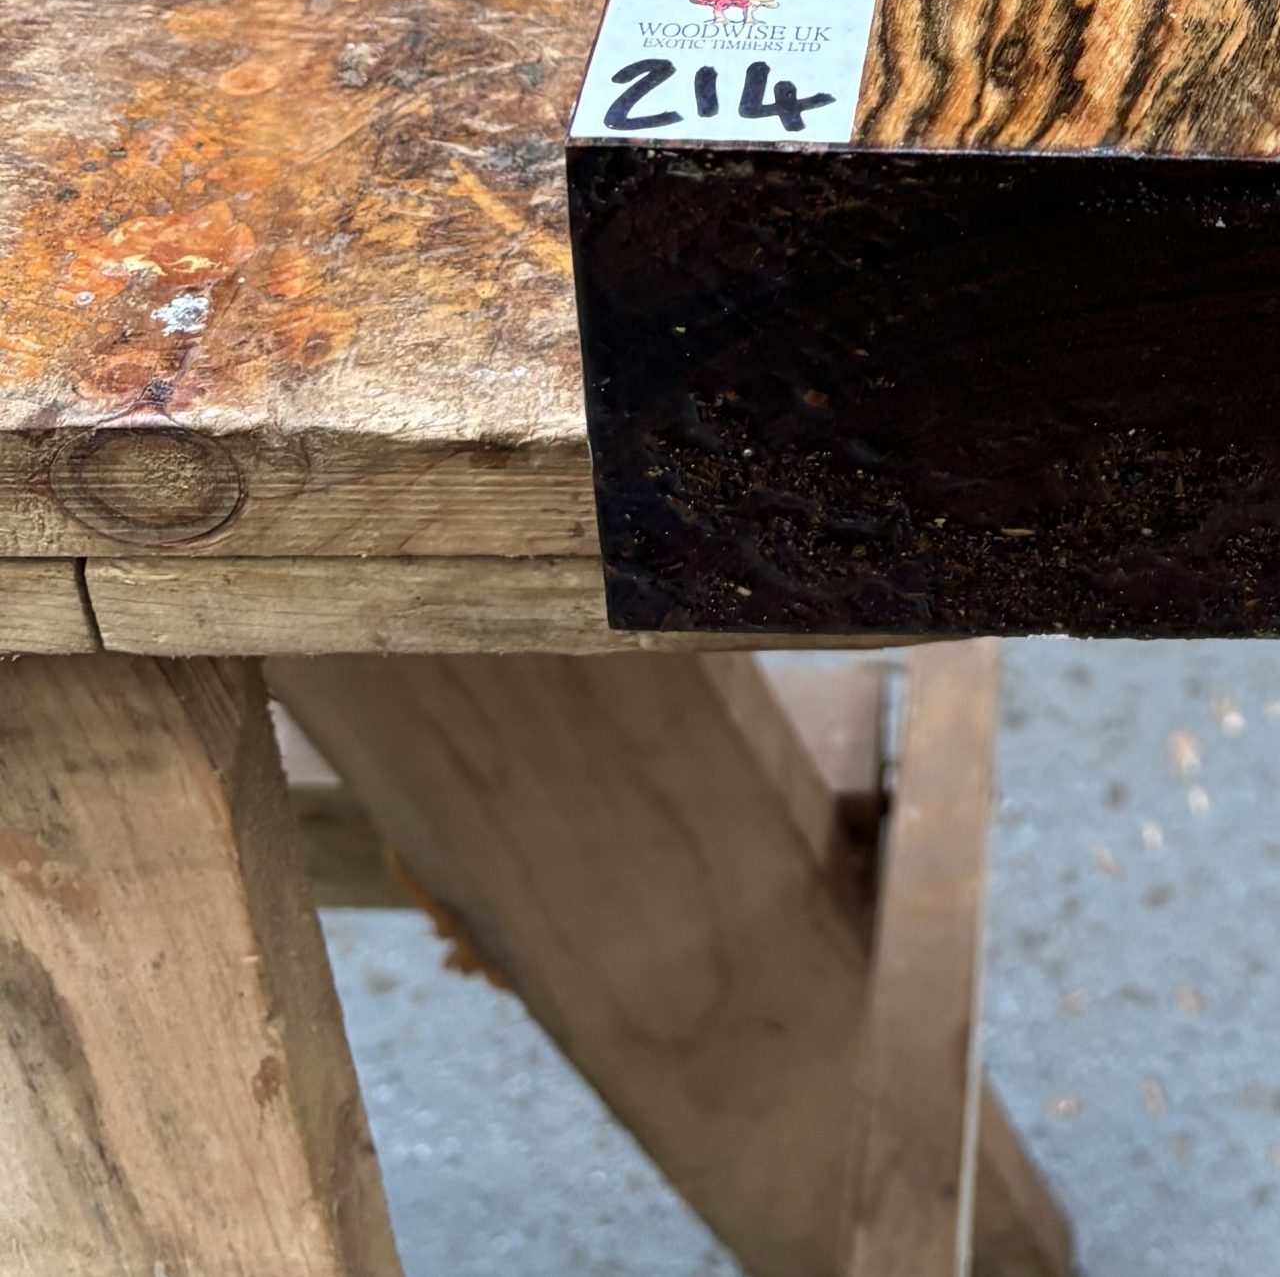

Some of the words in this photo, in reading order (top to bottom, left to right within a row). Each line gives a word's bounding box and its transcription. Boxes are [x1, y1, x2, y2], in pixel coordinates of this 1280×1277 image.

[638, 22, 786, 41] WOODWISE
[795, 26, 832, 42] UK
[642, 37, 706, 50] EXOTIC
[711, 39, 784, 52] TIMBERS
[788, 41, 822, 53] LTD
[603, 58, 837, 132] 214
